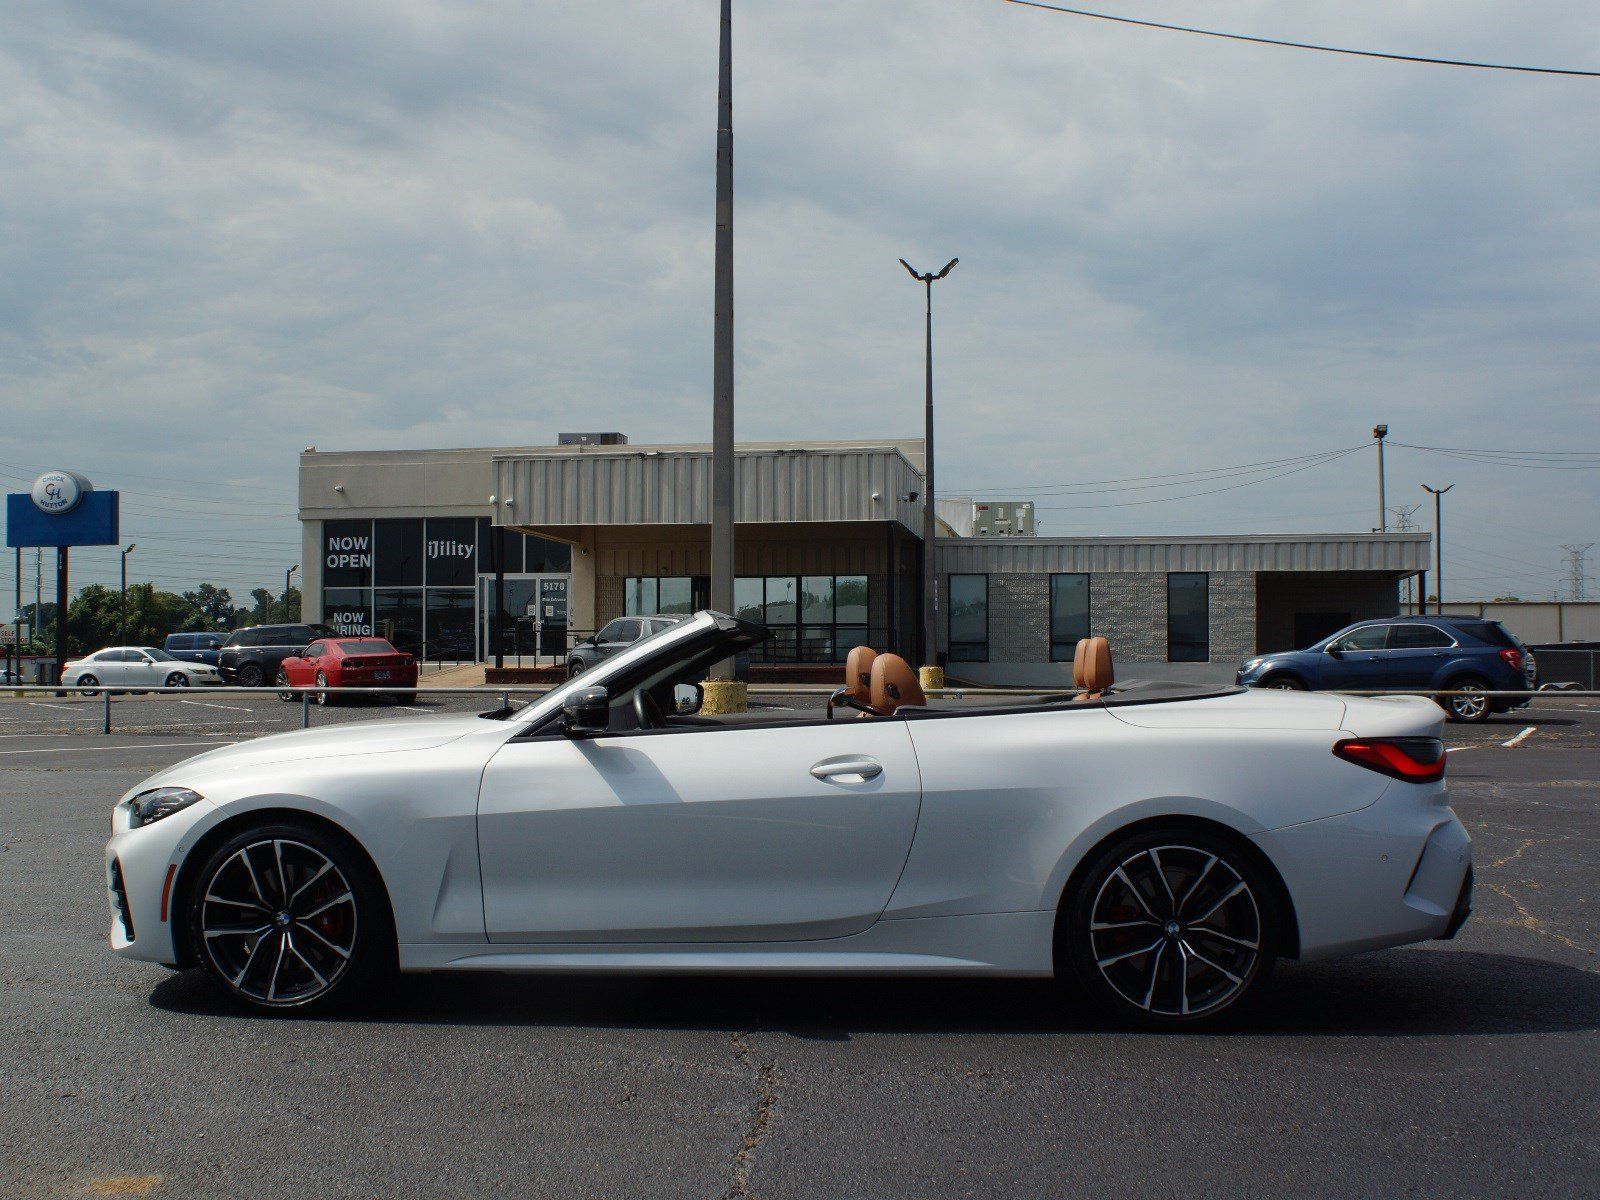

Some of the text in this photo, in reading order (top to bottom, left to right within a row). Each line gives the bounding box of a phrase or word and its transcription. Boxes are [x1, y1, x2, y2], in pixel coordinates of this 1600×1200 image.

[40, 498, 67, 508] HUTTON
[329, 536, 369, 551] NOW
[326, 554, 371, 568] OPEN
[543, 582, 565, 591] 5170
[333, 612, 364, 623] NOW
